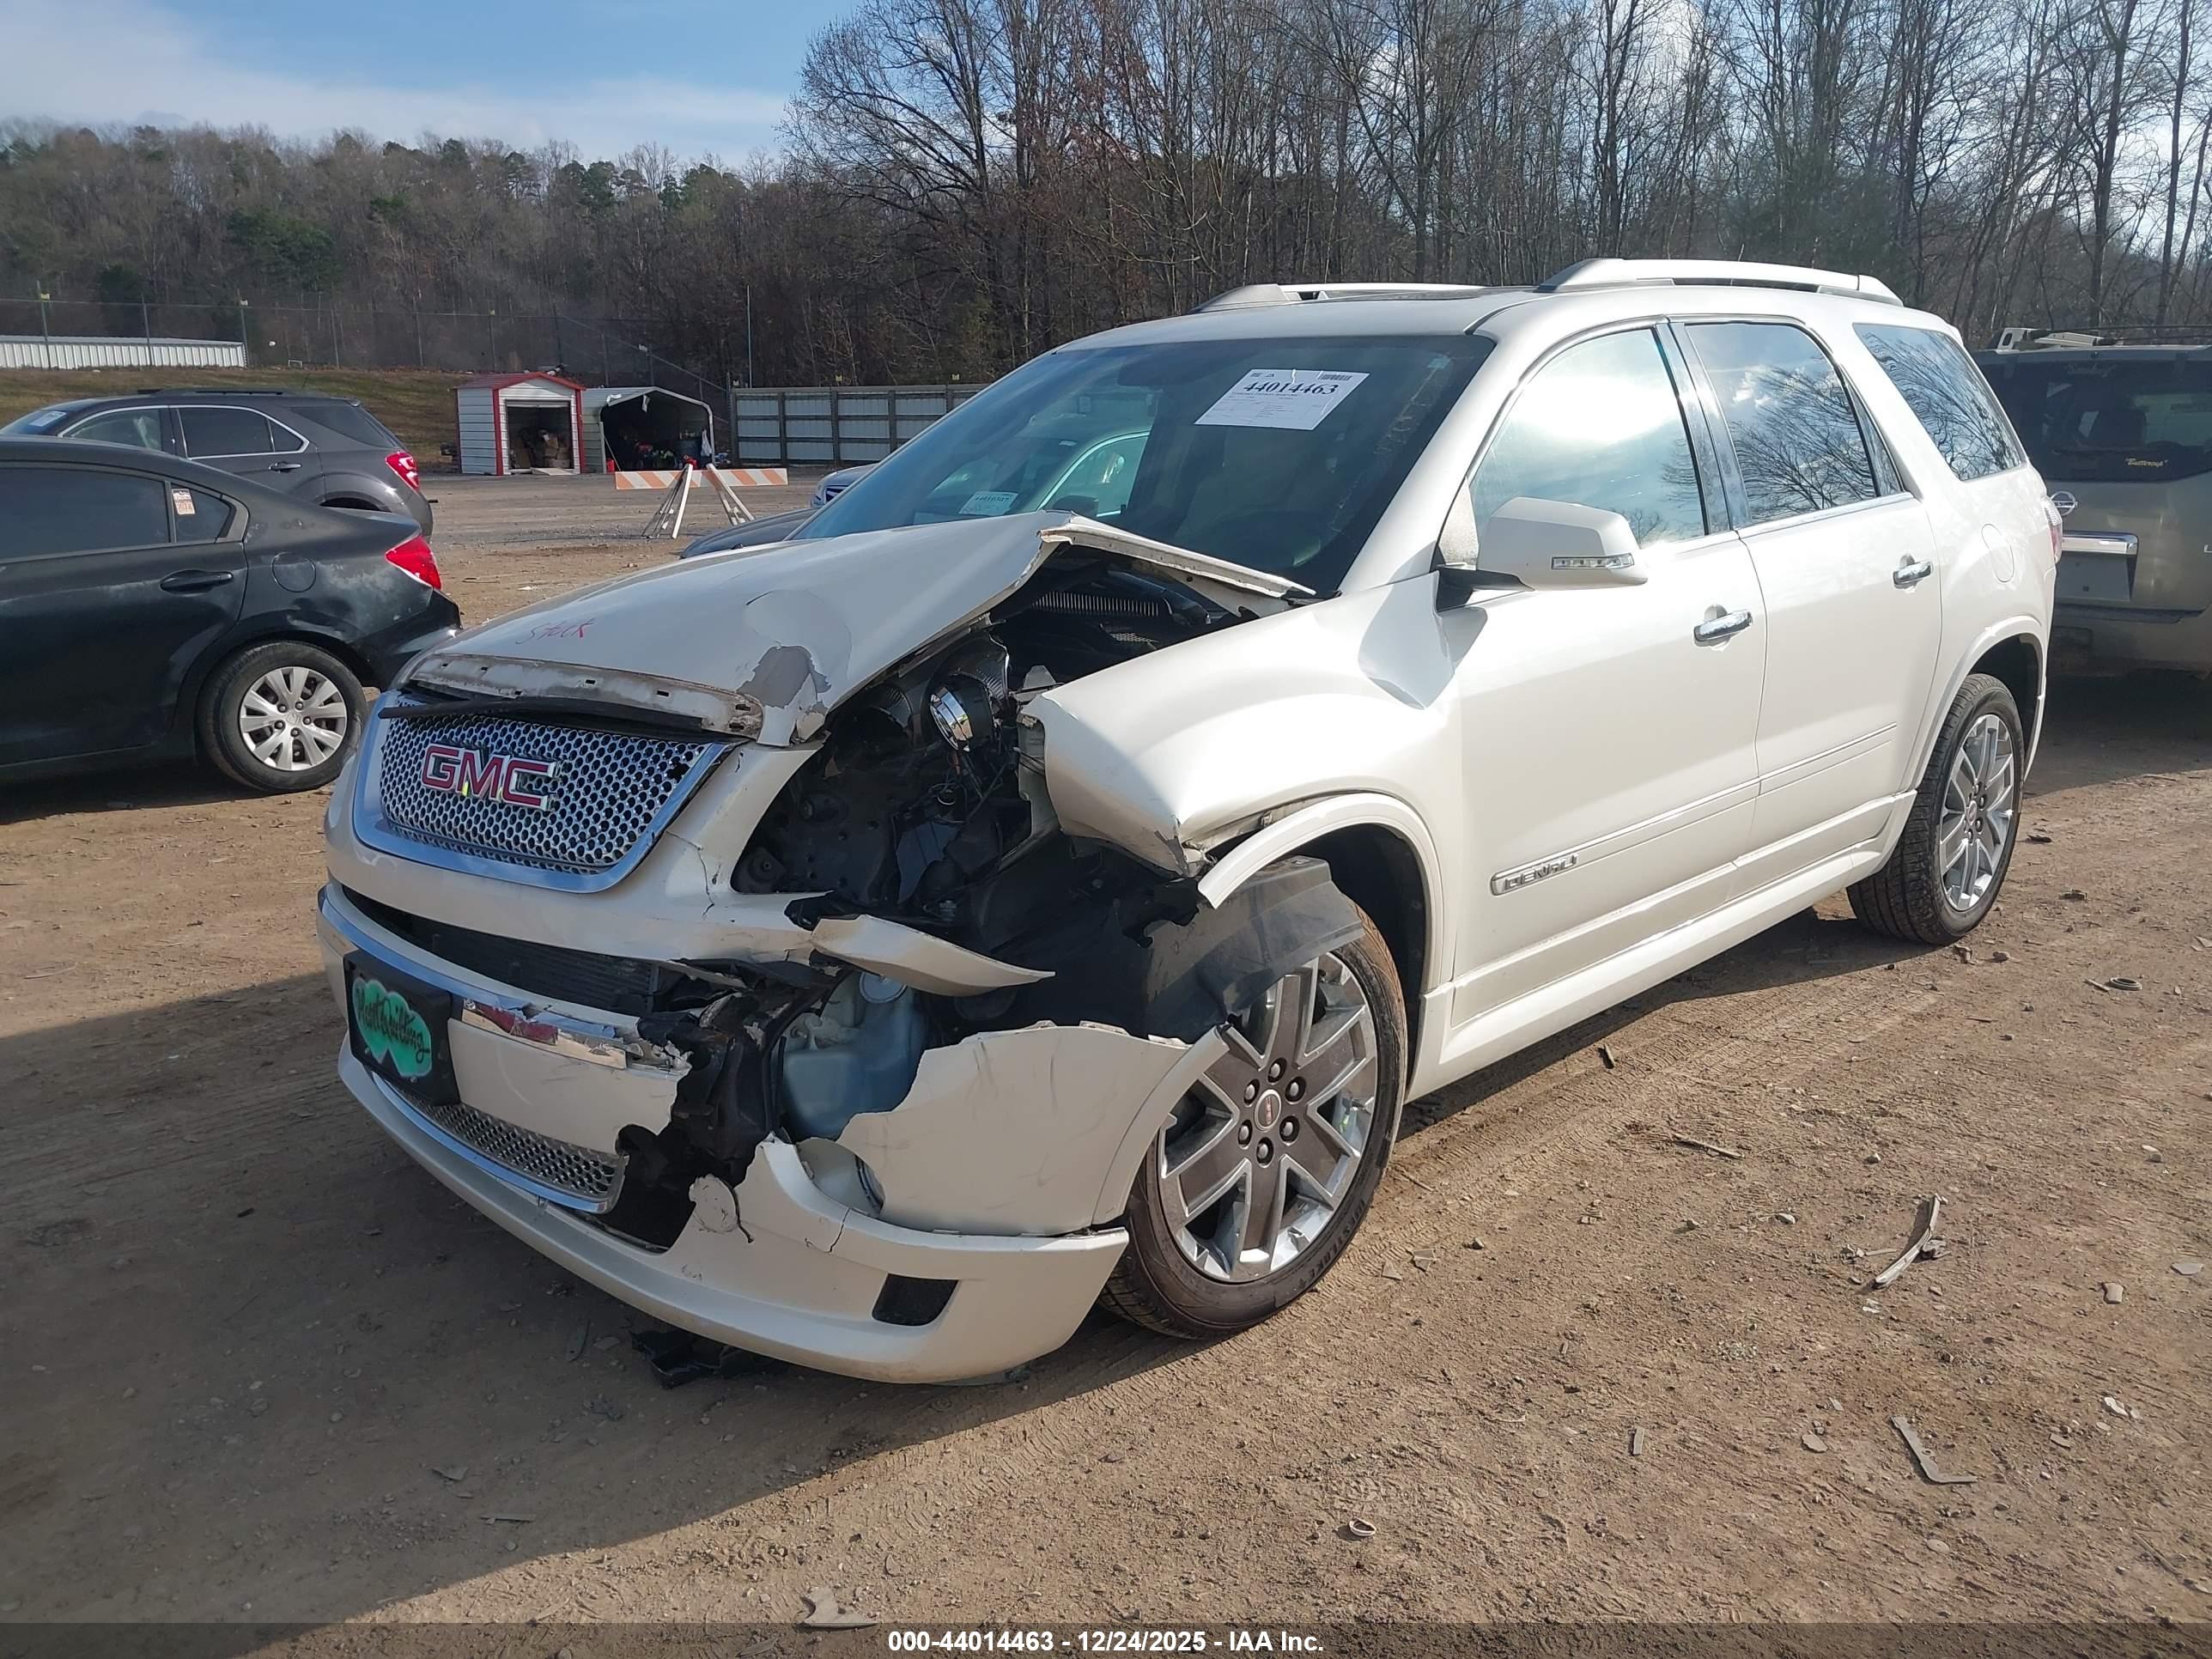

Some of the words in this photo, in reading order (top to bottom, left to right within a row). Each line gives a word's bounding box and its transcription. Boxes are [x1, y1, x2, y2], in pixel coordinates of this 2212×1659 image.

[1243, 381, 1340, 395] 44014463
[422, 743, 556, 811] GMC
[1310, 1199, 1367, 1279] WESTLAKE
